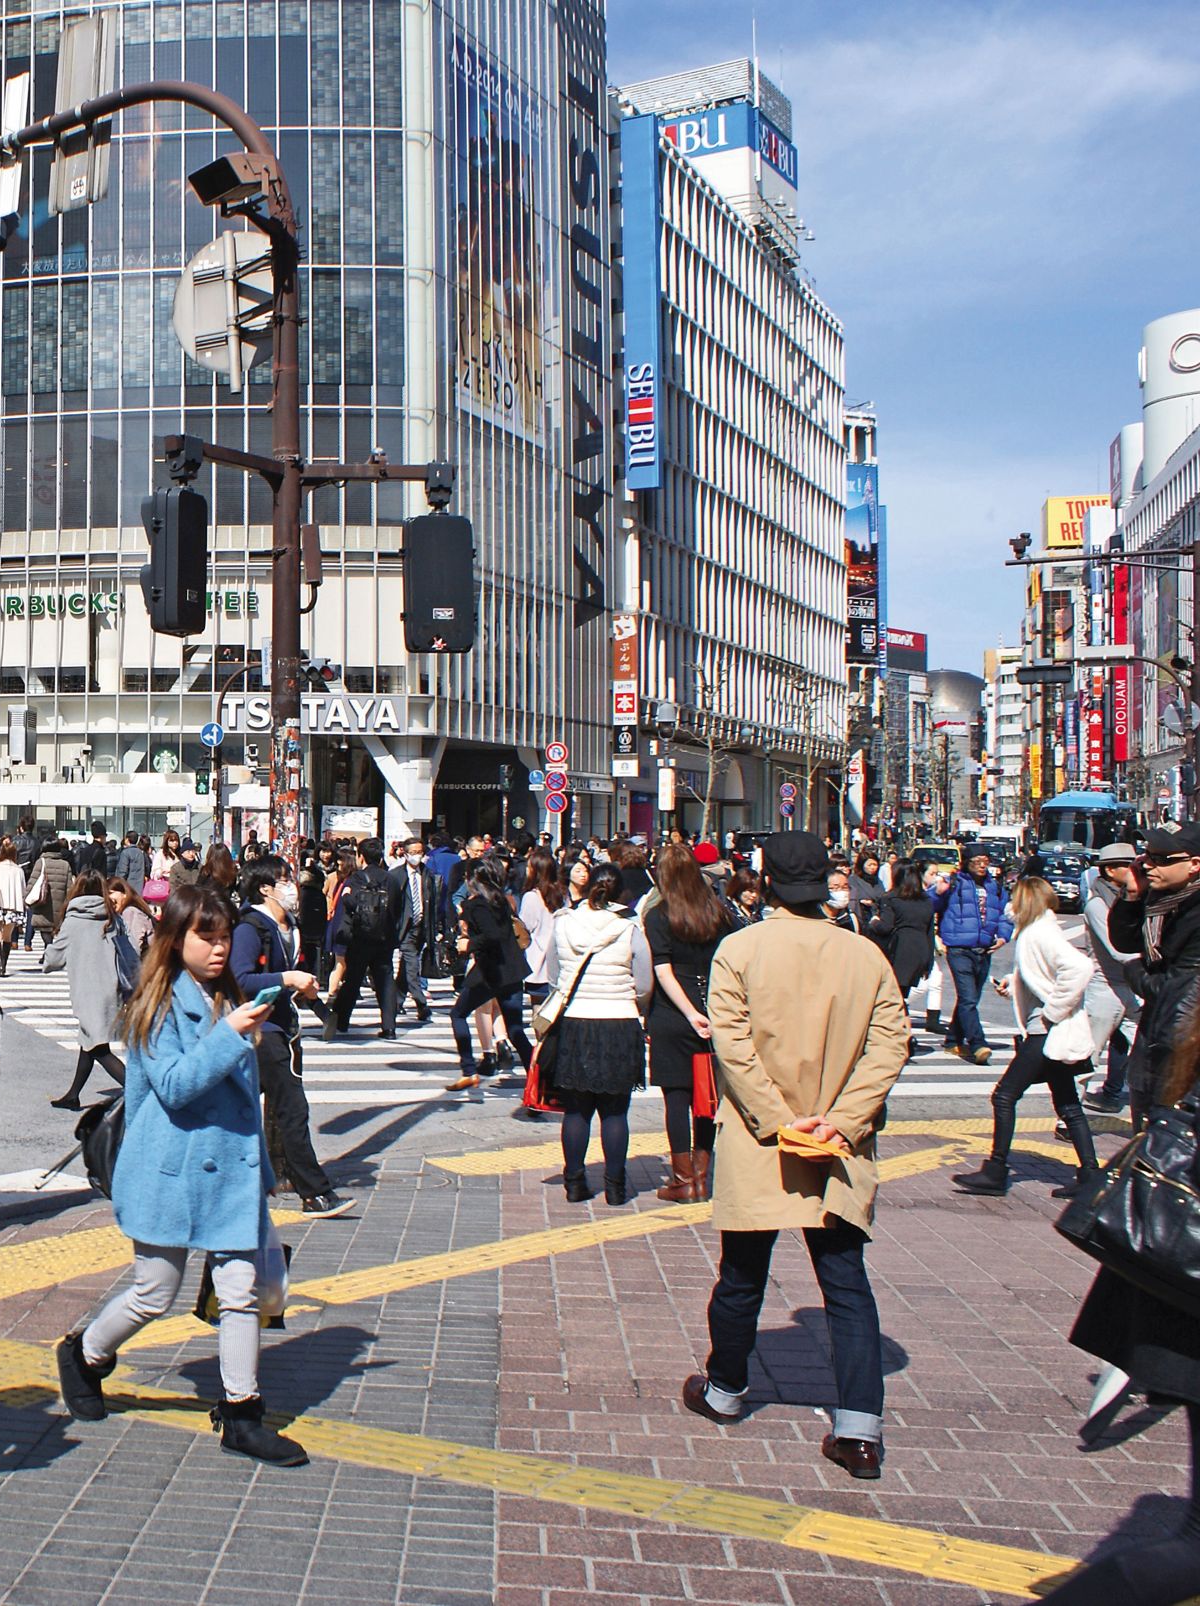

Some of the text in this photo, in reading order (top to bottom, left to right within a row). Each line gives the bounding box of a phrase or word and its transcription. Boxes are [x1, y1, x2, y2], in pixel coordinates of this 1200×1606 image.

[627, 362, 655, 471] SEIBU
[222, 697, 400, 731] TSTAYA
[617, 695, 633, 712] 本
[434, 783, 476, 791] TARBUCKS
